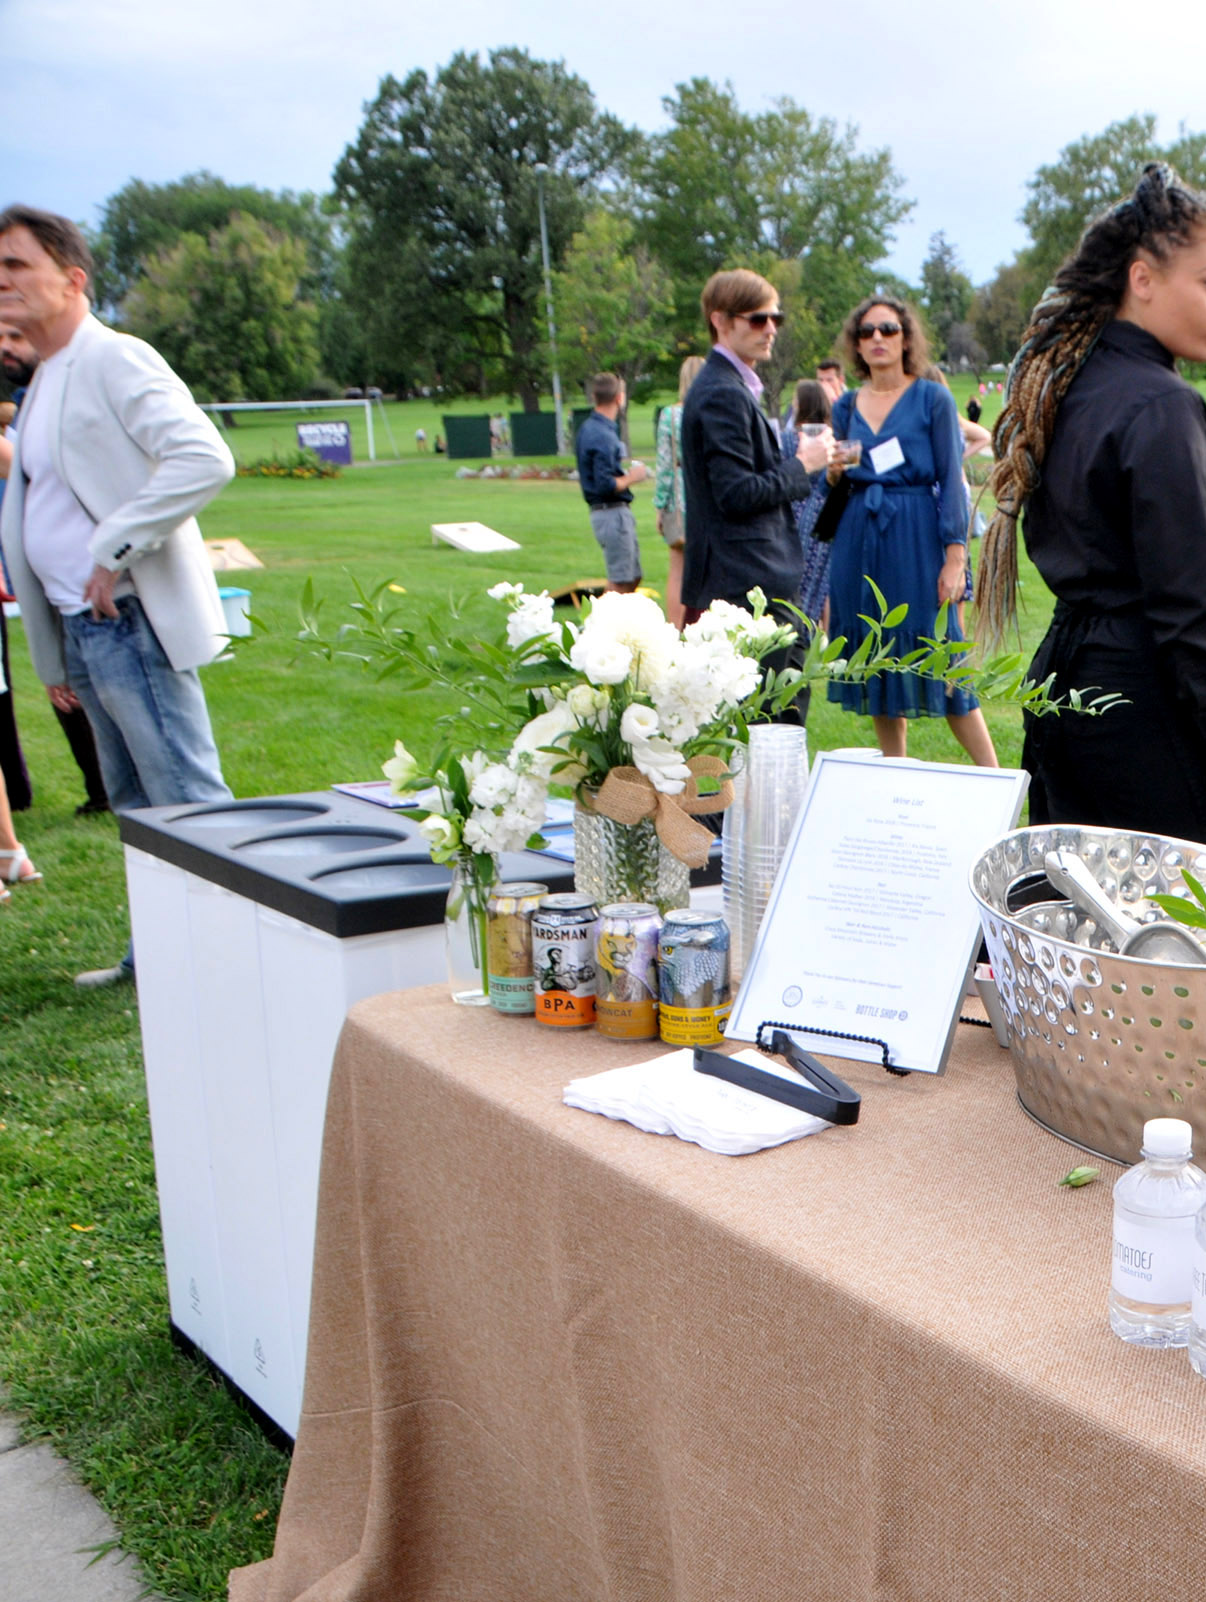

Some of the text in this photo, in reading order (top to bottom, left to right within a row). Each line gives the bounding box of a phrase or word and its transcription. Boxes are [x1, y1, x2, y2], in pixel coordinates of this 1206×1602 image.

[534, 927, 588, 941] ARDSMAN
[544, 998, 575, 1012] BPA
[856, 1004, 879, 1018] BOTTLE
[880, 1007, 898, 1020] SHOP
